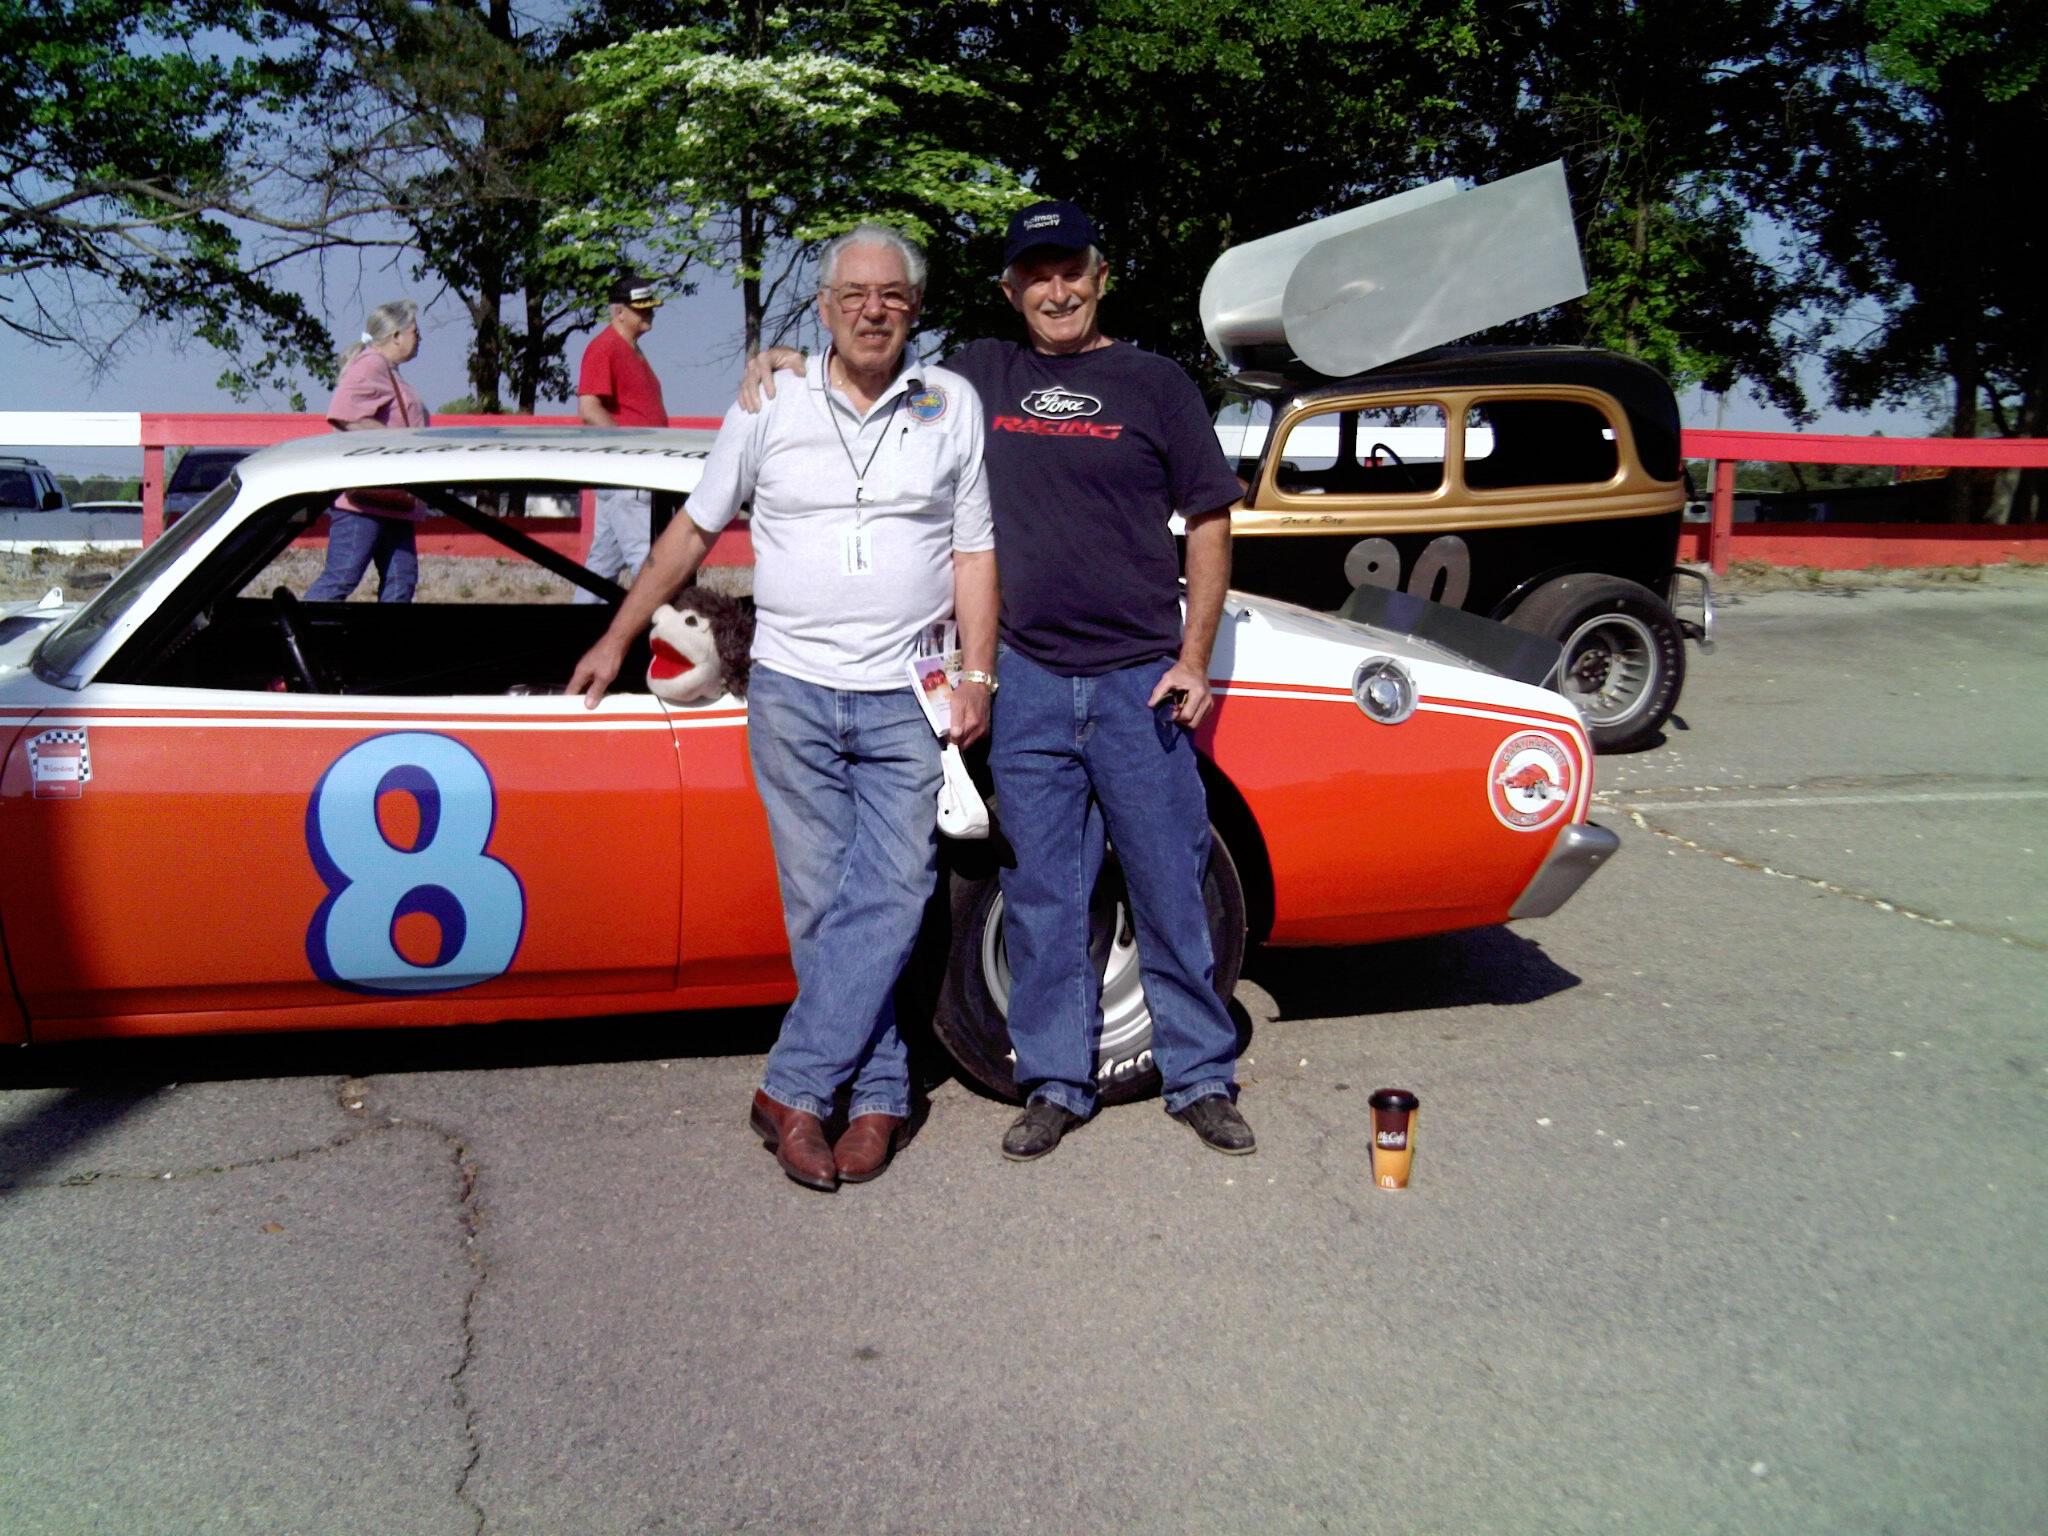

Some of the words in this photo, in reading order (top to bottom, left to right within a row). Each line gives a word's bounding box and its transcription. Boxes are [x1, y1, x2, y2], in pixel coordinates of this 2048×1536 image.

[1035, 391, 1085, 412] Ford
[992, 416, 1123, 440] RACING
[344, 443, 464, 457] Dale
[468, 442, 710, 460] Earnhard
[304, 728, 528, 997] 8
